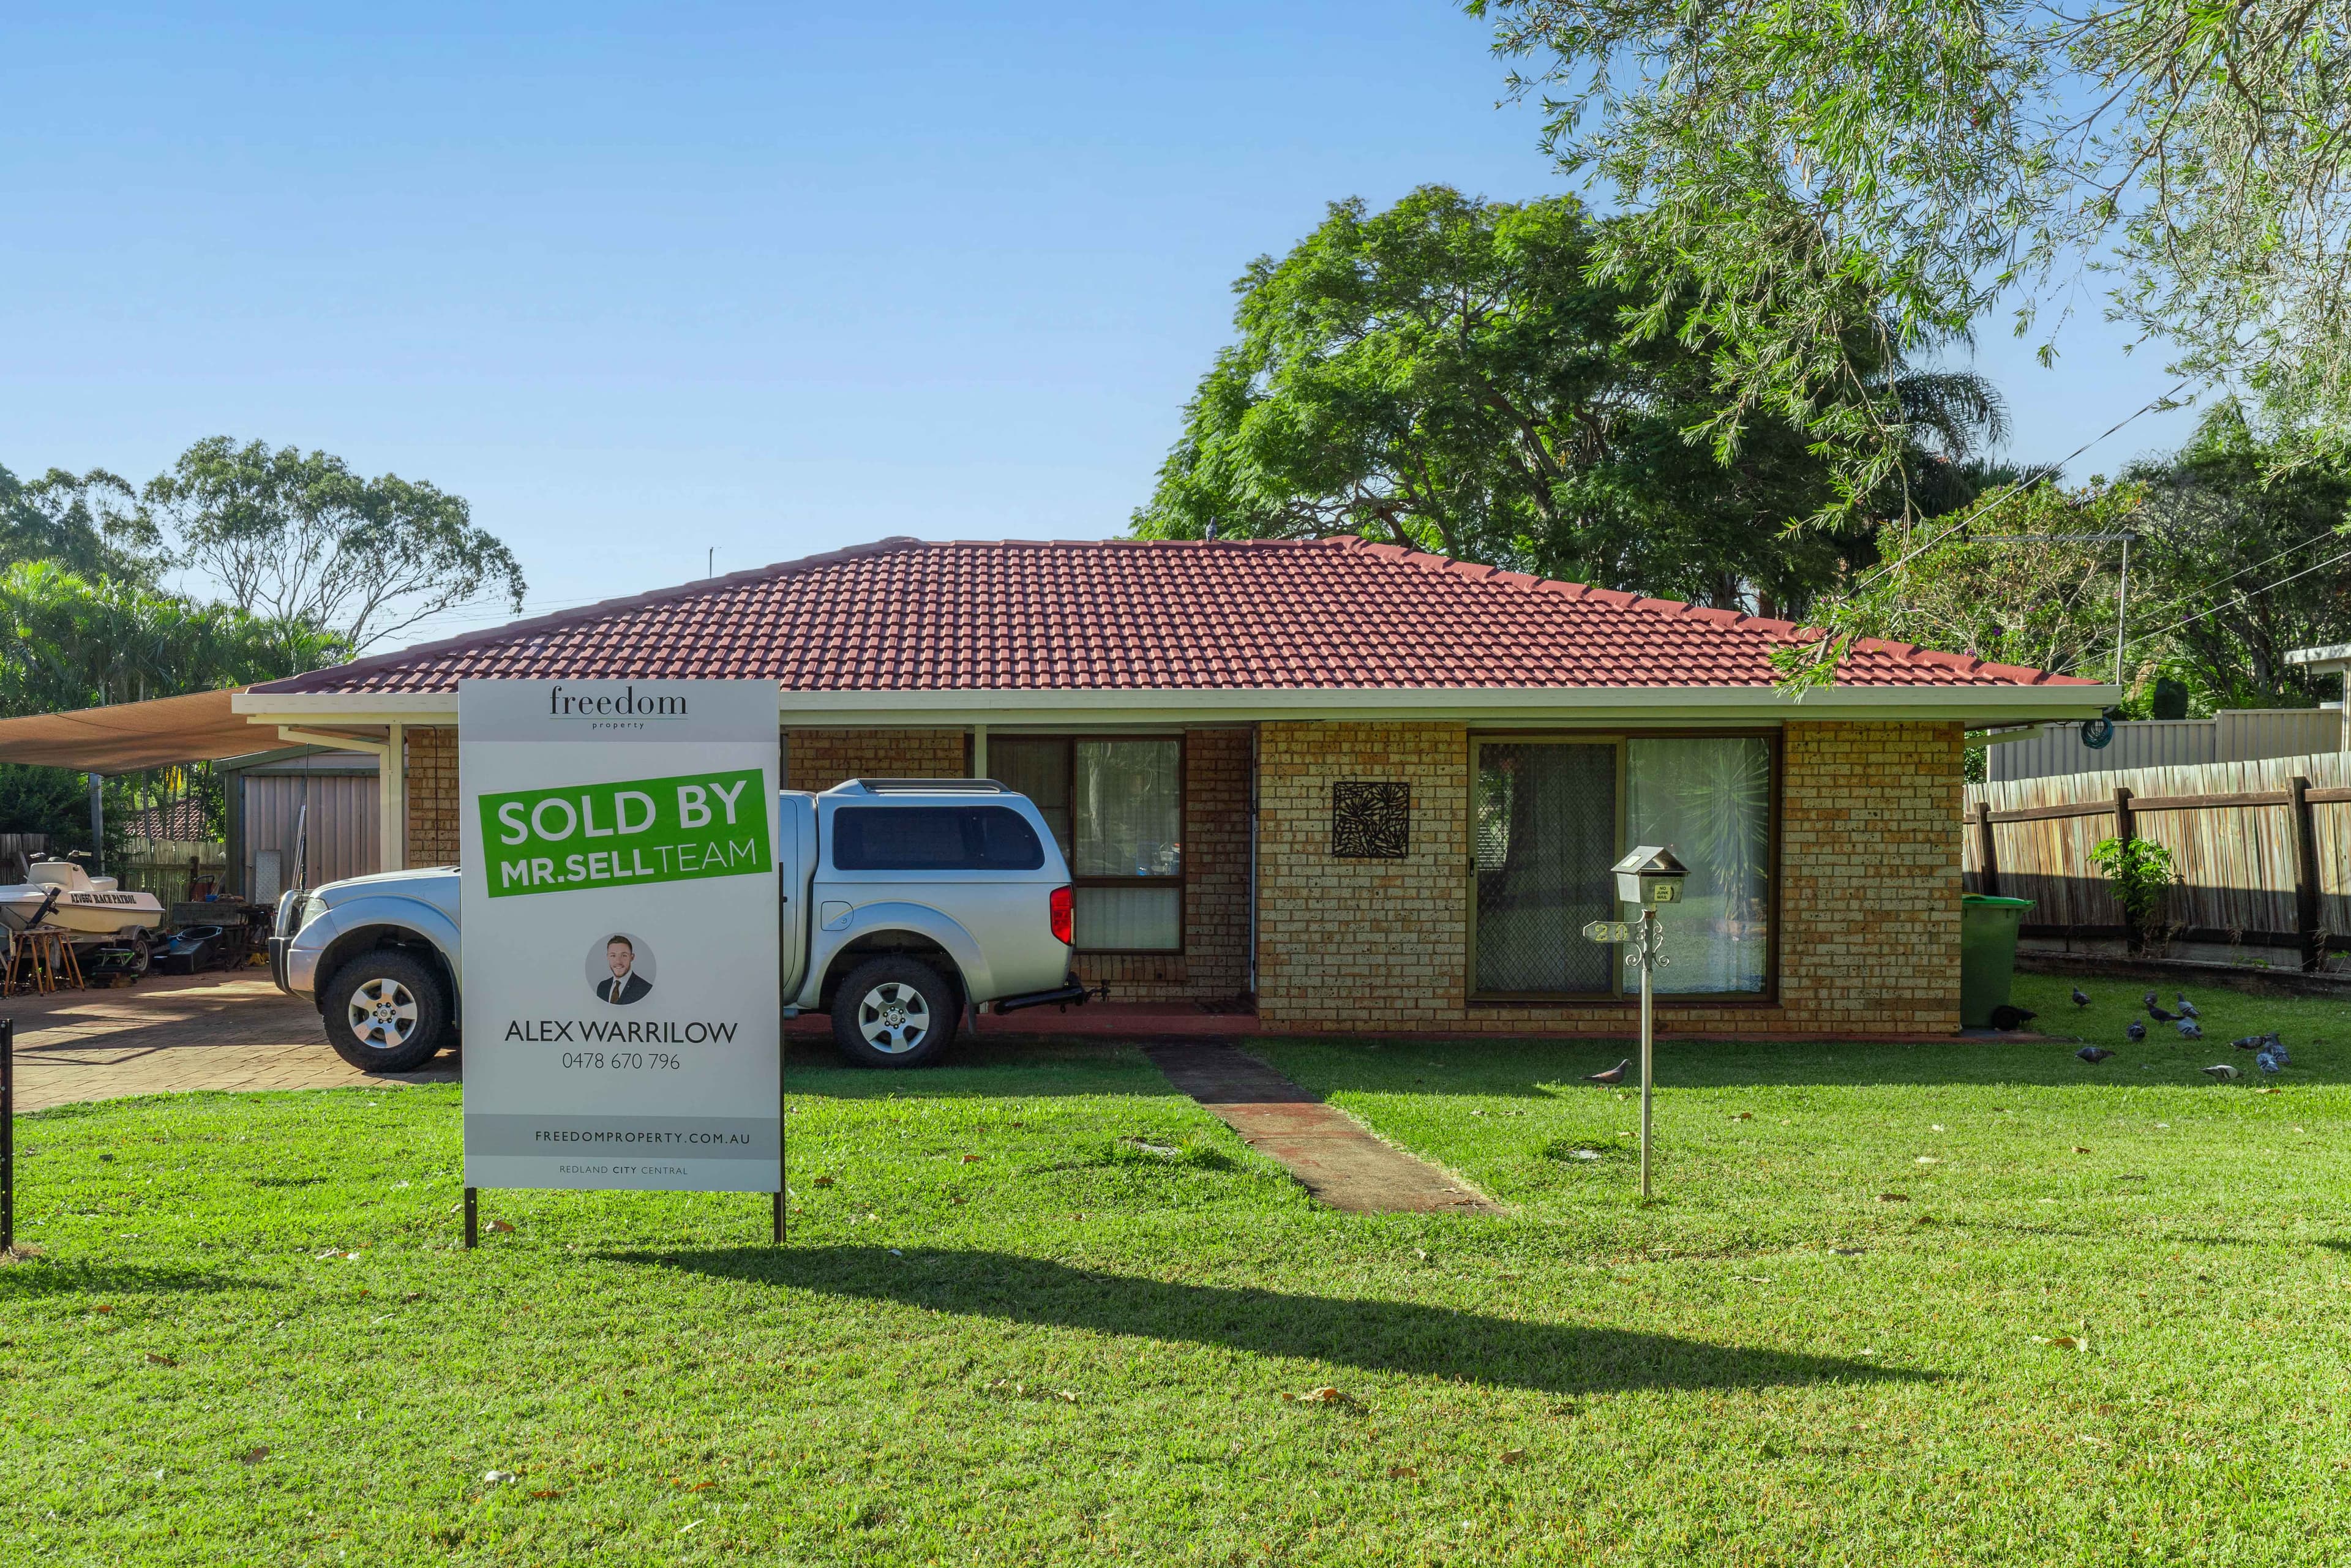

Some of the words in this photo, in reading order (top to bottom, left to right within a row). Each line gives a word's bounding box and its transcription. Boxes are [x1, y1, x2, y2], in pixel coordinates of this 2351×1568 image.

[549, 685, 688, 715] freedom
[498, 790, 656, 845] SOLD
[677, 780, 748, 828] BY
[93, 895, 112, 904] RACE
[111, 895, 137, 904] PATROL
[1595, 924, 1628, 941] 20
[504, 1021, 574, 1041] ALEX
[579, 1021, 738, 1044] WARRILOW
[563, 1052, 604, 1068] 0478
[611, 1053, 643, 1069] 670
[648, 1054, 680, 1070] 796
[536, 1131, 750, 1144] FREEDOMPROPERTY.COM.AU
